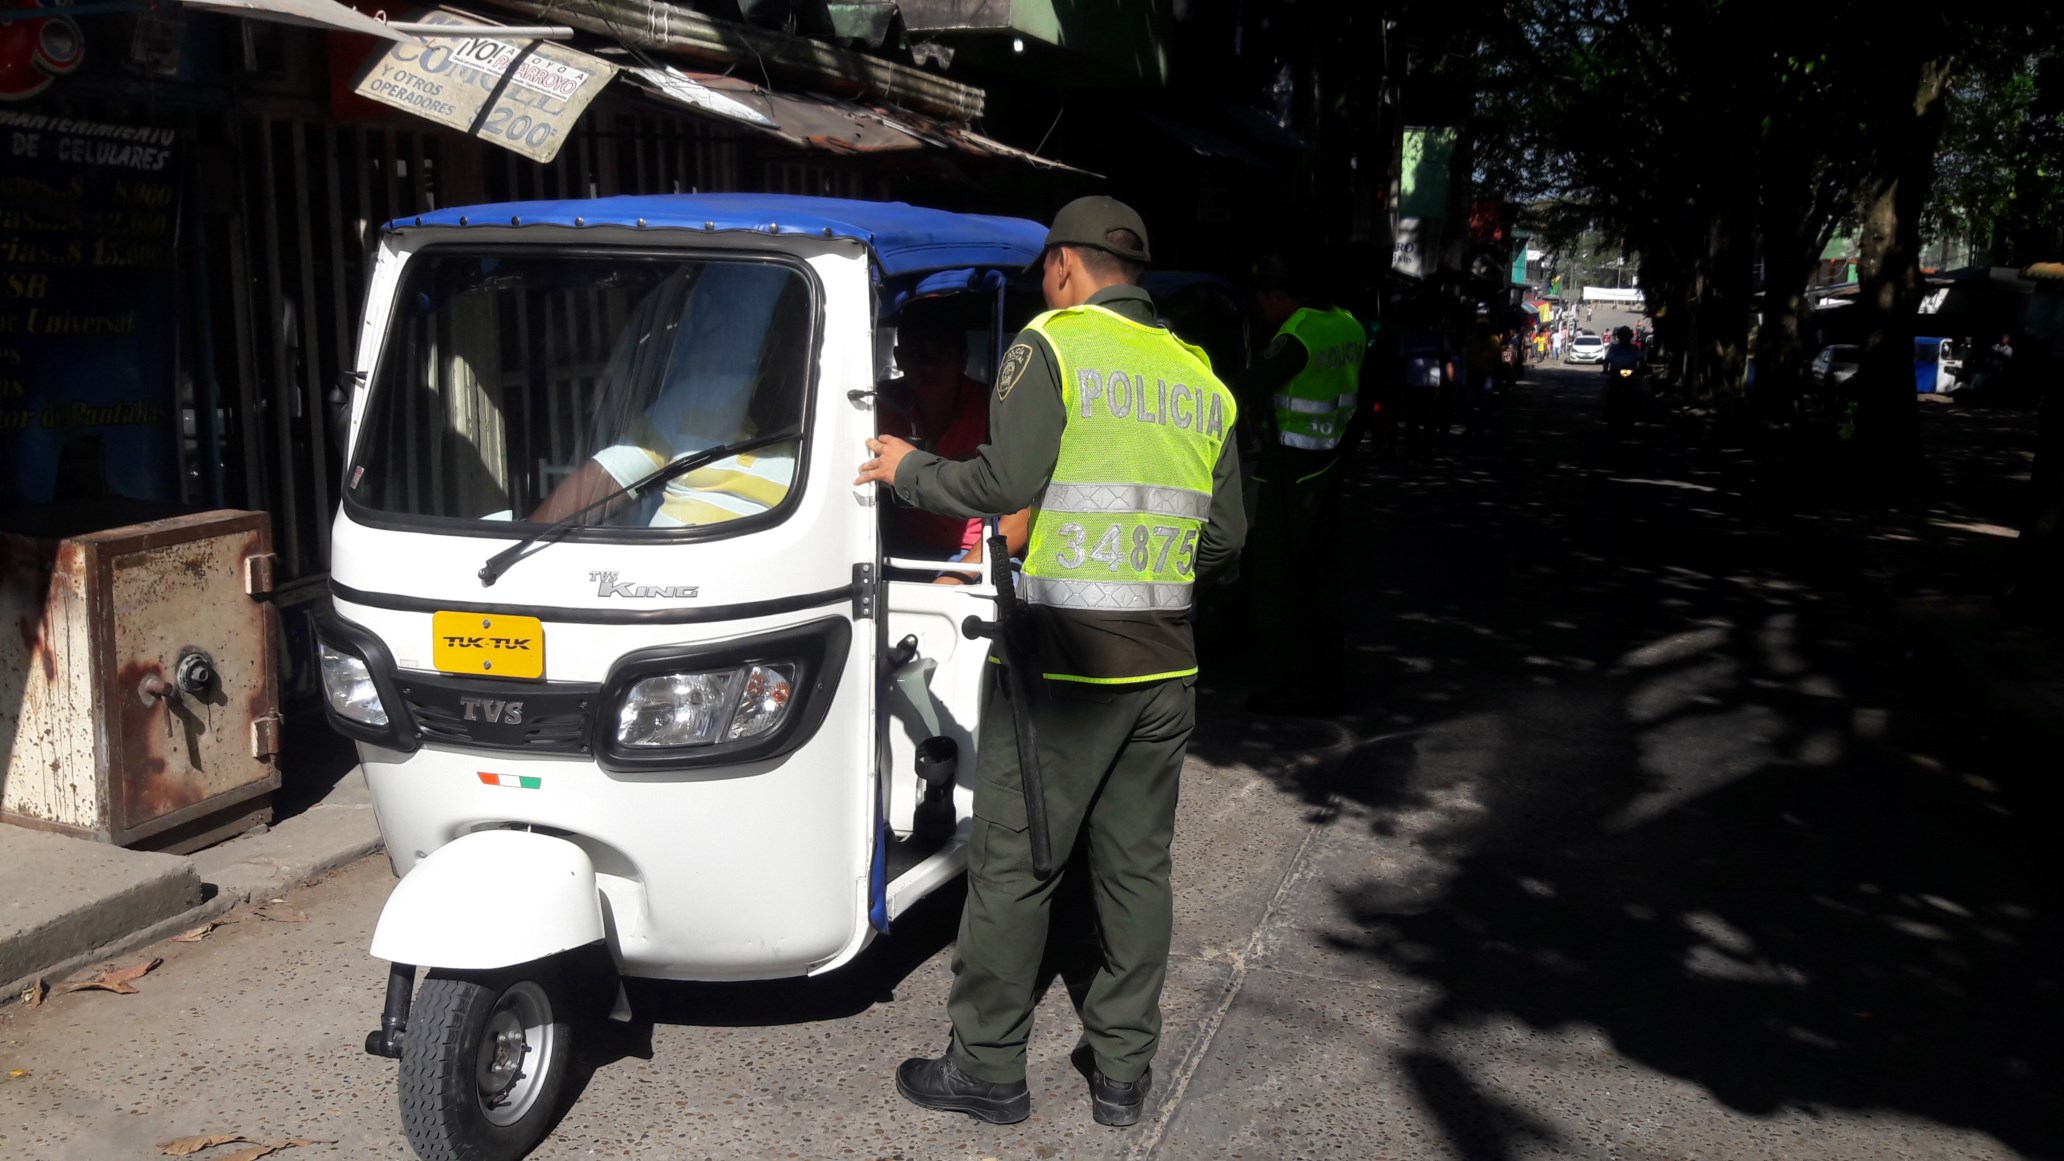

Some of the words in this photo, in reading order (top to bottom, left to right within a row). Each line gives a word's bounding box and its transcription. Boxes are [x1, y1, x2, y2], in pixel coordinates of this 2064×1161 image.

[381, 63, 394, 77] Y
[393, 69, 444, 96] OTROS
[492, 54, 578, 95] PAARROYO
[369, 79, 456, 116] OPERADORES
[11, 131, 41, 158] DE
[57, 136, 170, 171] CELULARES
[0, 271, 48, 300] SB
[26, 307, 136, 335] Universal
[1076, 367, 1224, 441] POLICIA
[1055, 523, 1197, 576] 34875
[589, 570, 619, 583] TVS
[597, 582, 699, 598] KING
[442, 636, 532, 650] TUK-TUK
[460, 696, 523, 725] TVS
